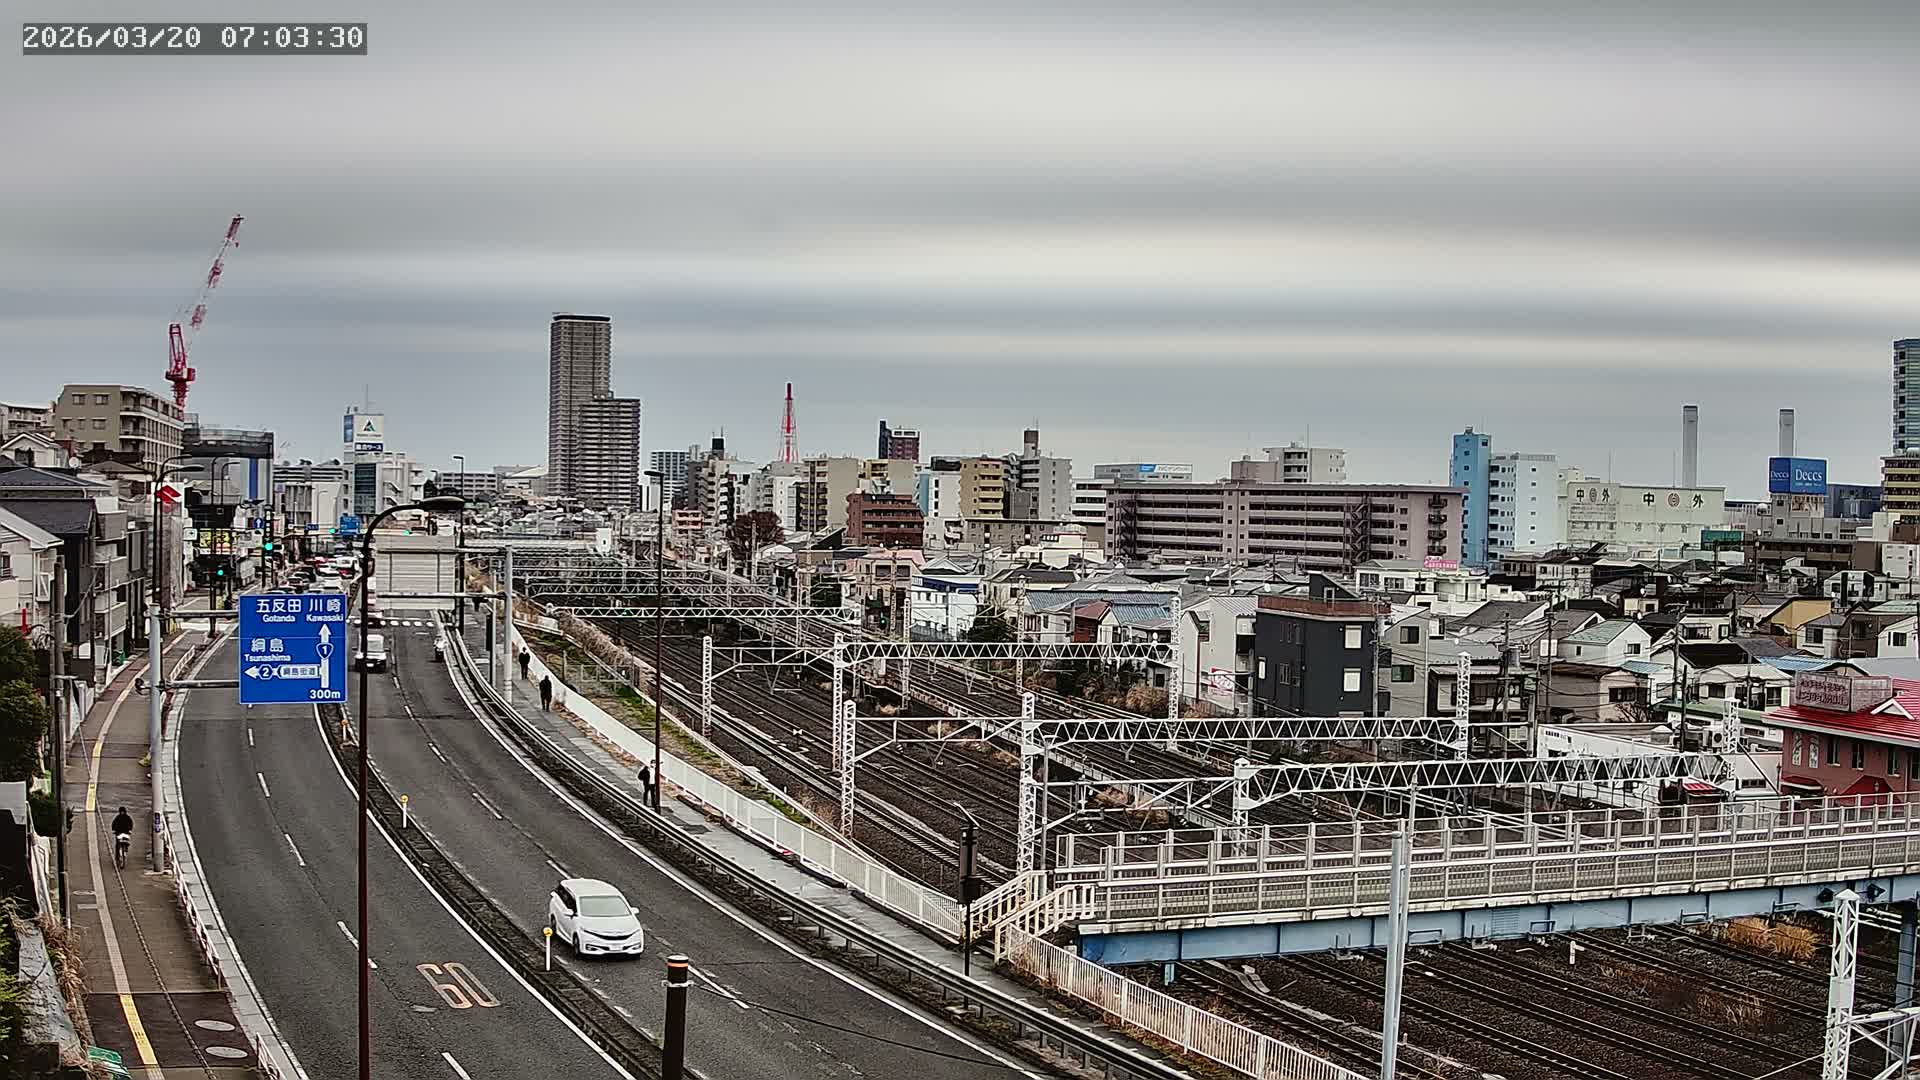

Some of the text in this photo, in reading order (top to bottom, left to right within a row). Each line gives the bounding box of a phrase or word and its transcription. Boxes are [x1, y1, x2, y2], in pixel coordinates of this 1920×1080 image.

[256, 598, 341, 613] 五反田 川崎
[262, 614, 344, 622] Gotanda Kawasaki
[322, 646, 328, 655] 1
[244, 654, 292, 662] Tsunashima
[262, 667, 269, 677] 2
[310, 689, 341, 699] 300m
[416, 962, 500, 1009] 60
